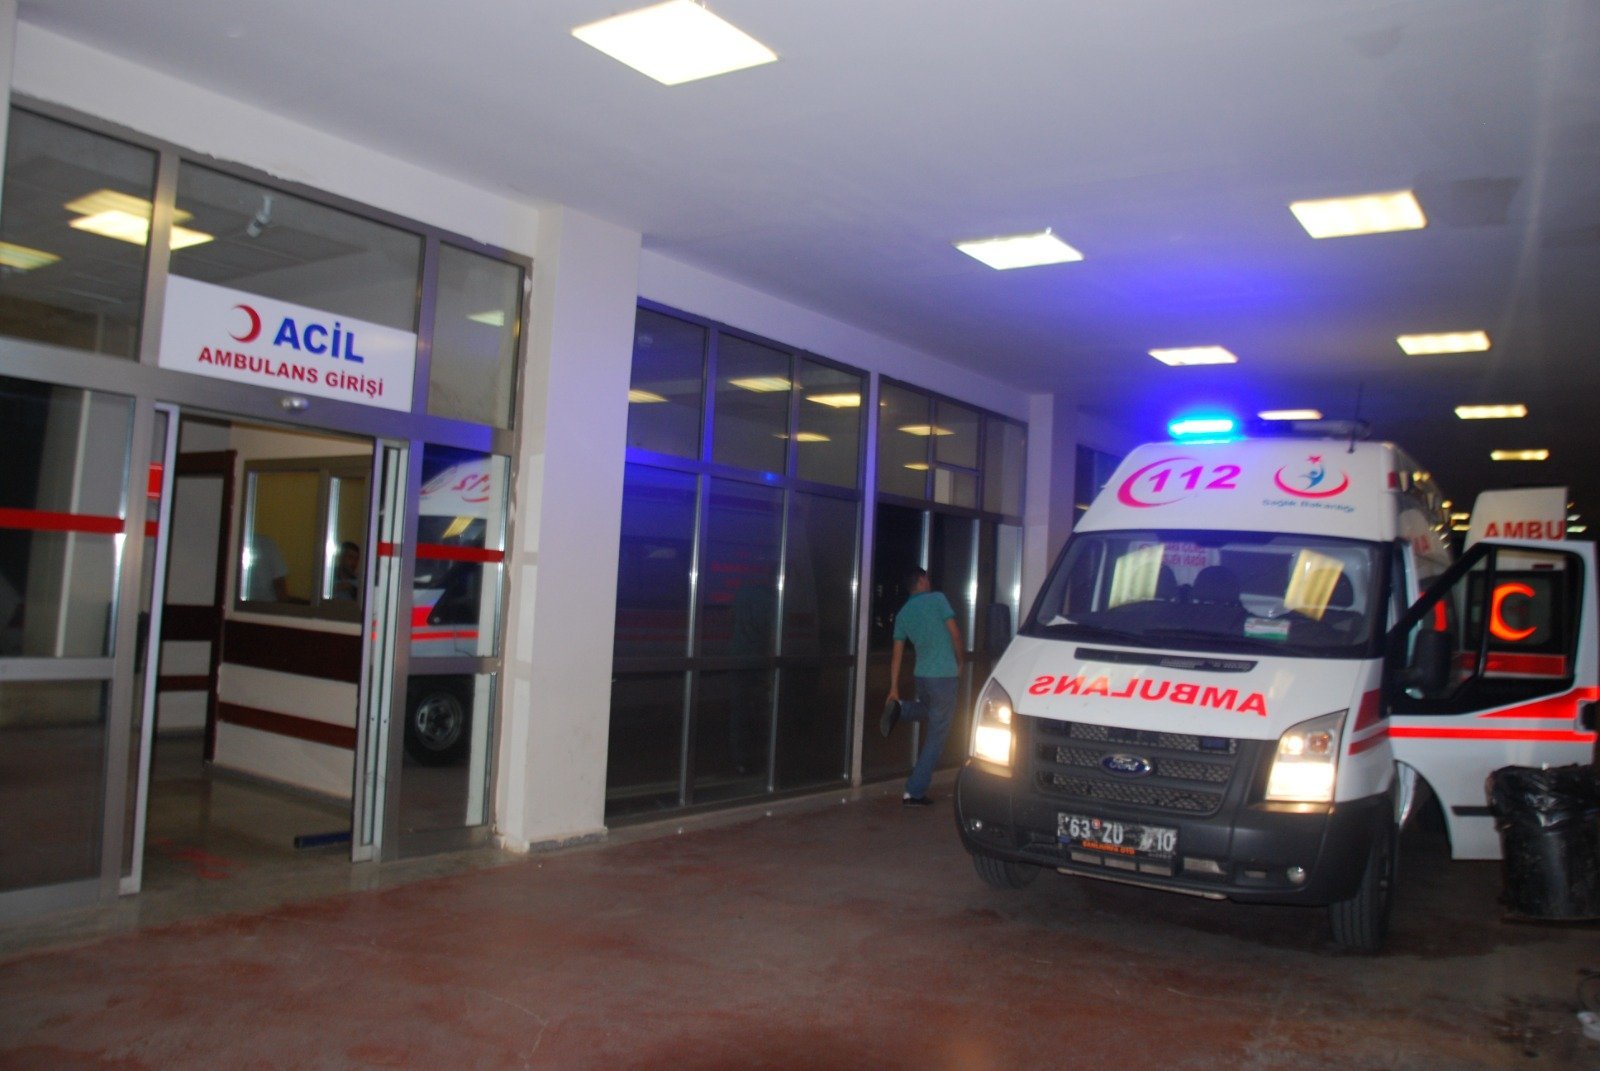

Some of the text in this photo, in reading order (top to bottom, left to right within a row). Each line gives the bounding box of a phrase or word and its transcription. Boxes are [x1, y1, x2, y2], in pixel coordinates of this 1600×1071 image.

[273, 316, 364, 363] ACİL
[199, 346, 383, 398] AMBULANS GİRİŞİ
[1148, 464, 1242, 494] 112
[1484, 519, 1566, 541] AMBU
[1069, 818, 1091, 839] 63
